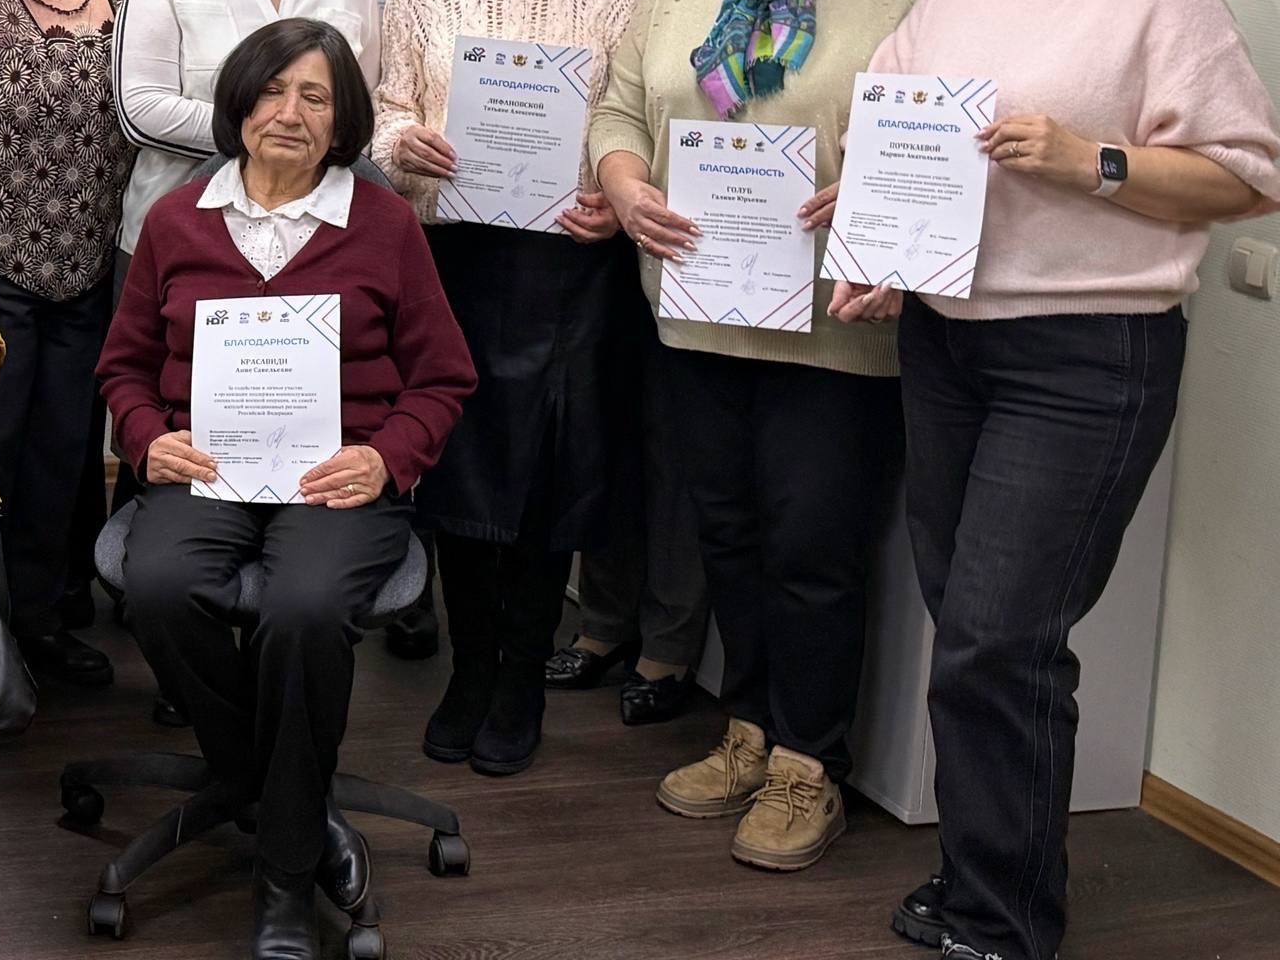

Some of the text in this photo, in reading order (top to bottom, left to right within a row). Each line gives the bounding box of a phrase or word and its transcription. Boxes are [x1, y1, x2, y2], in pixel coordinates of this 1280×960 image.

[479, 78, 560, 94] БЛАГОДАРНОСТЬ
[877, 119, 961, 133] БЛАГОДАРНОСТЬ
[699, 164, 785, 178] БЛАГОДАРНОСТЬ
[726, 186, 752, 194] ГОЛУБ
[737, 196, 767, 204] Юрьевне
[224, 338, 309, 347] БЛАГОДАРНОСТЬ
